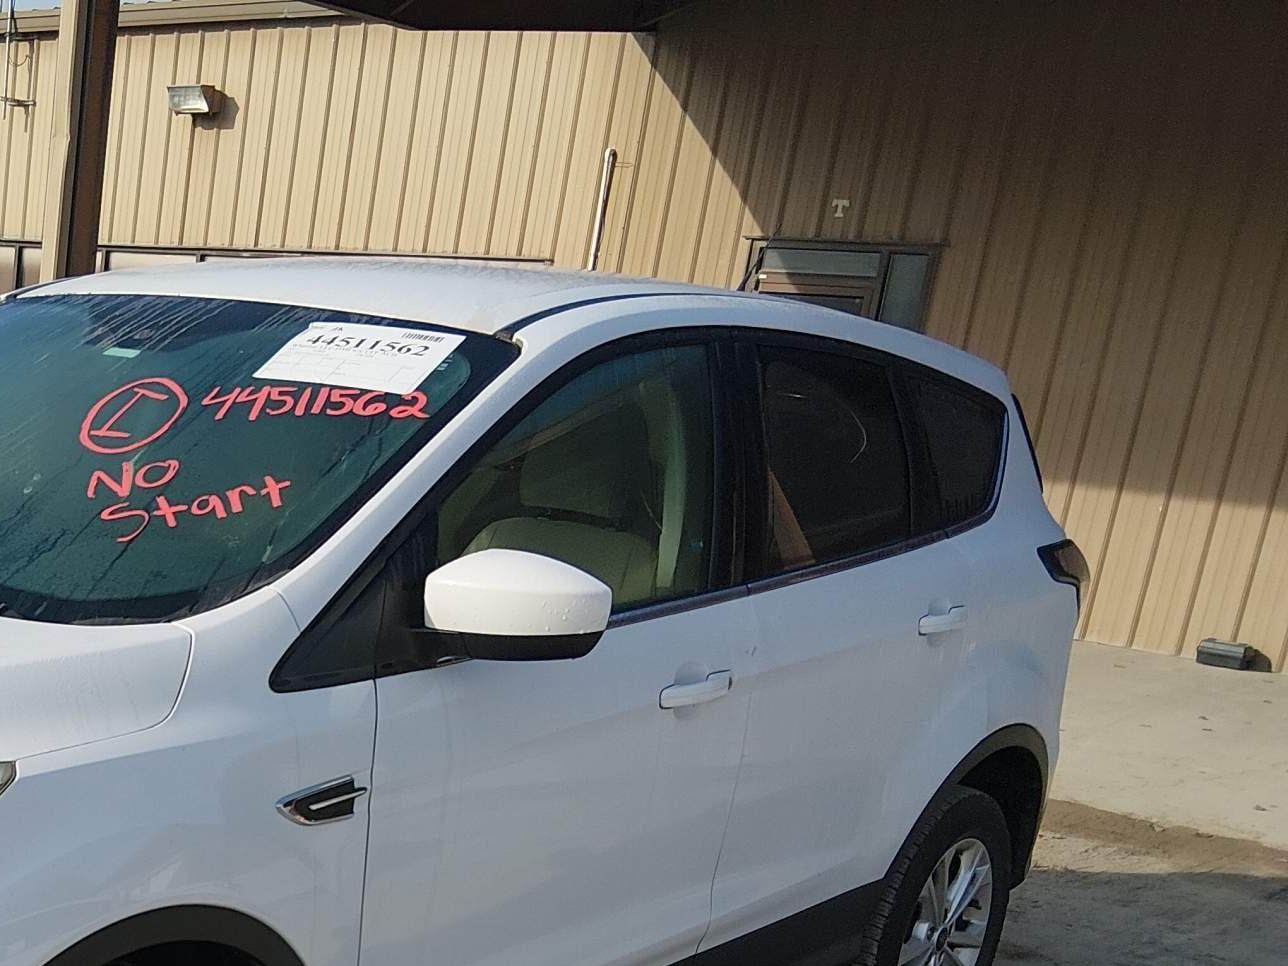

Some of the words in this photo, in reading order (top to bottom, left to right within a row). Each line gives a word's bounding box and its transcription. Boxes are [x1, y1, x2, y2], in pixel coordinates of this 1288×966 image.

[831, 198, 850, 218] T
[306, 334, 430, 357] 44511562
[201, 385, 430, 421] 44511562
[100, 475, 292, 543] Start
